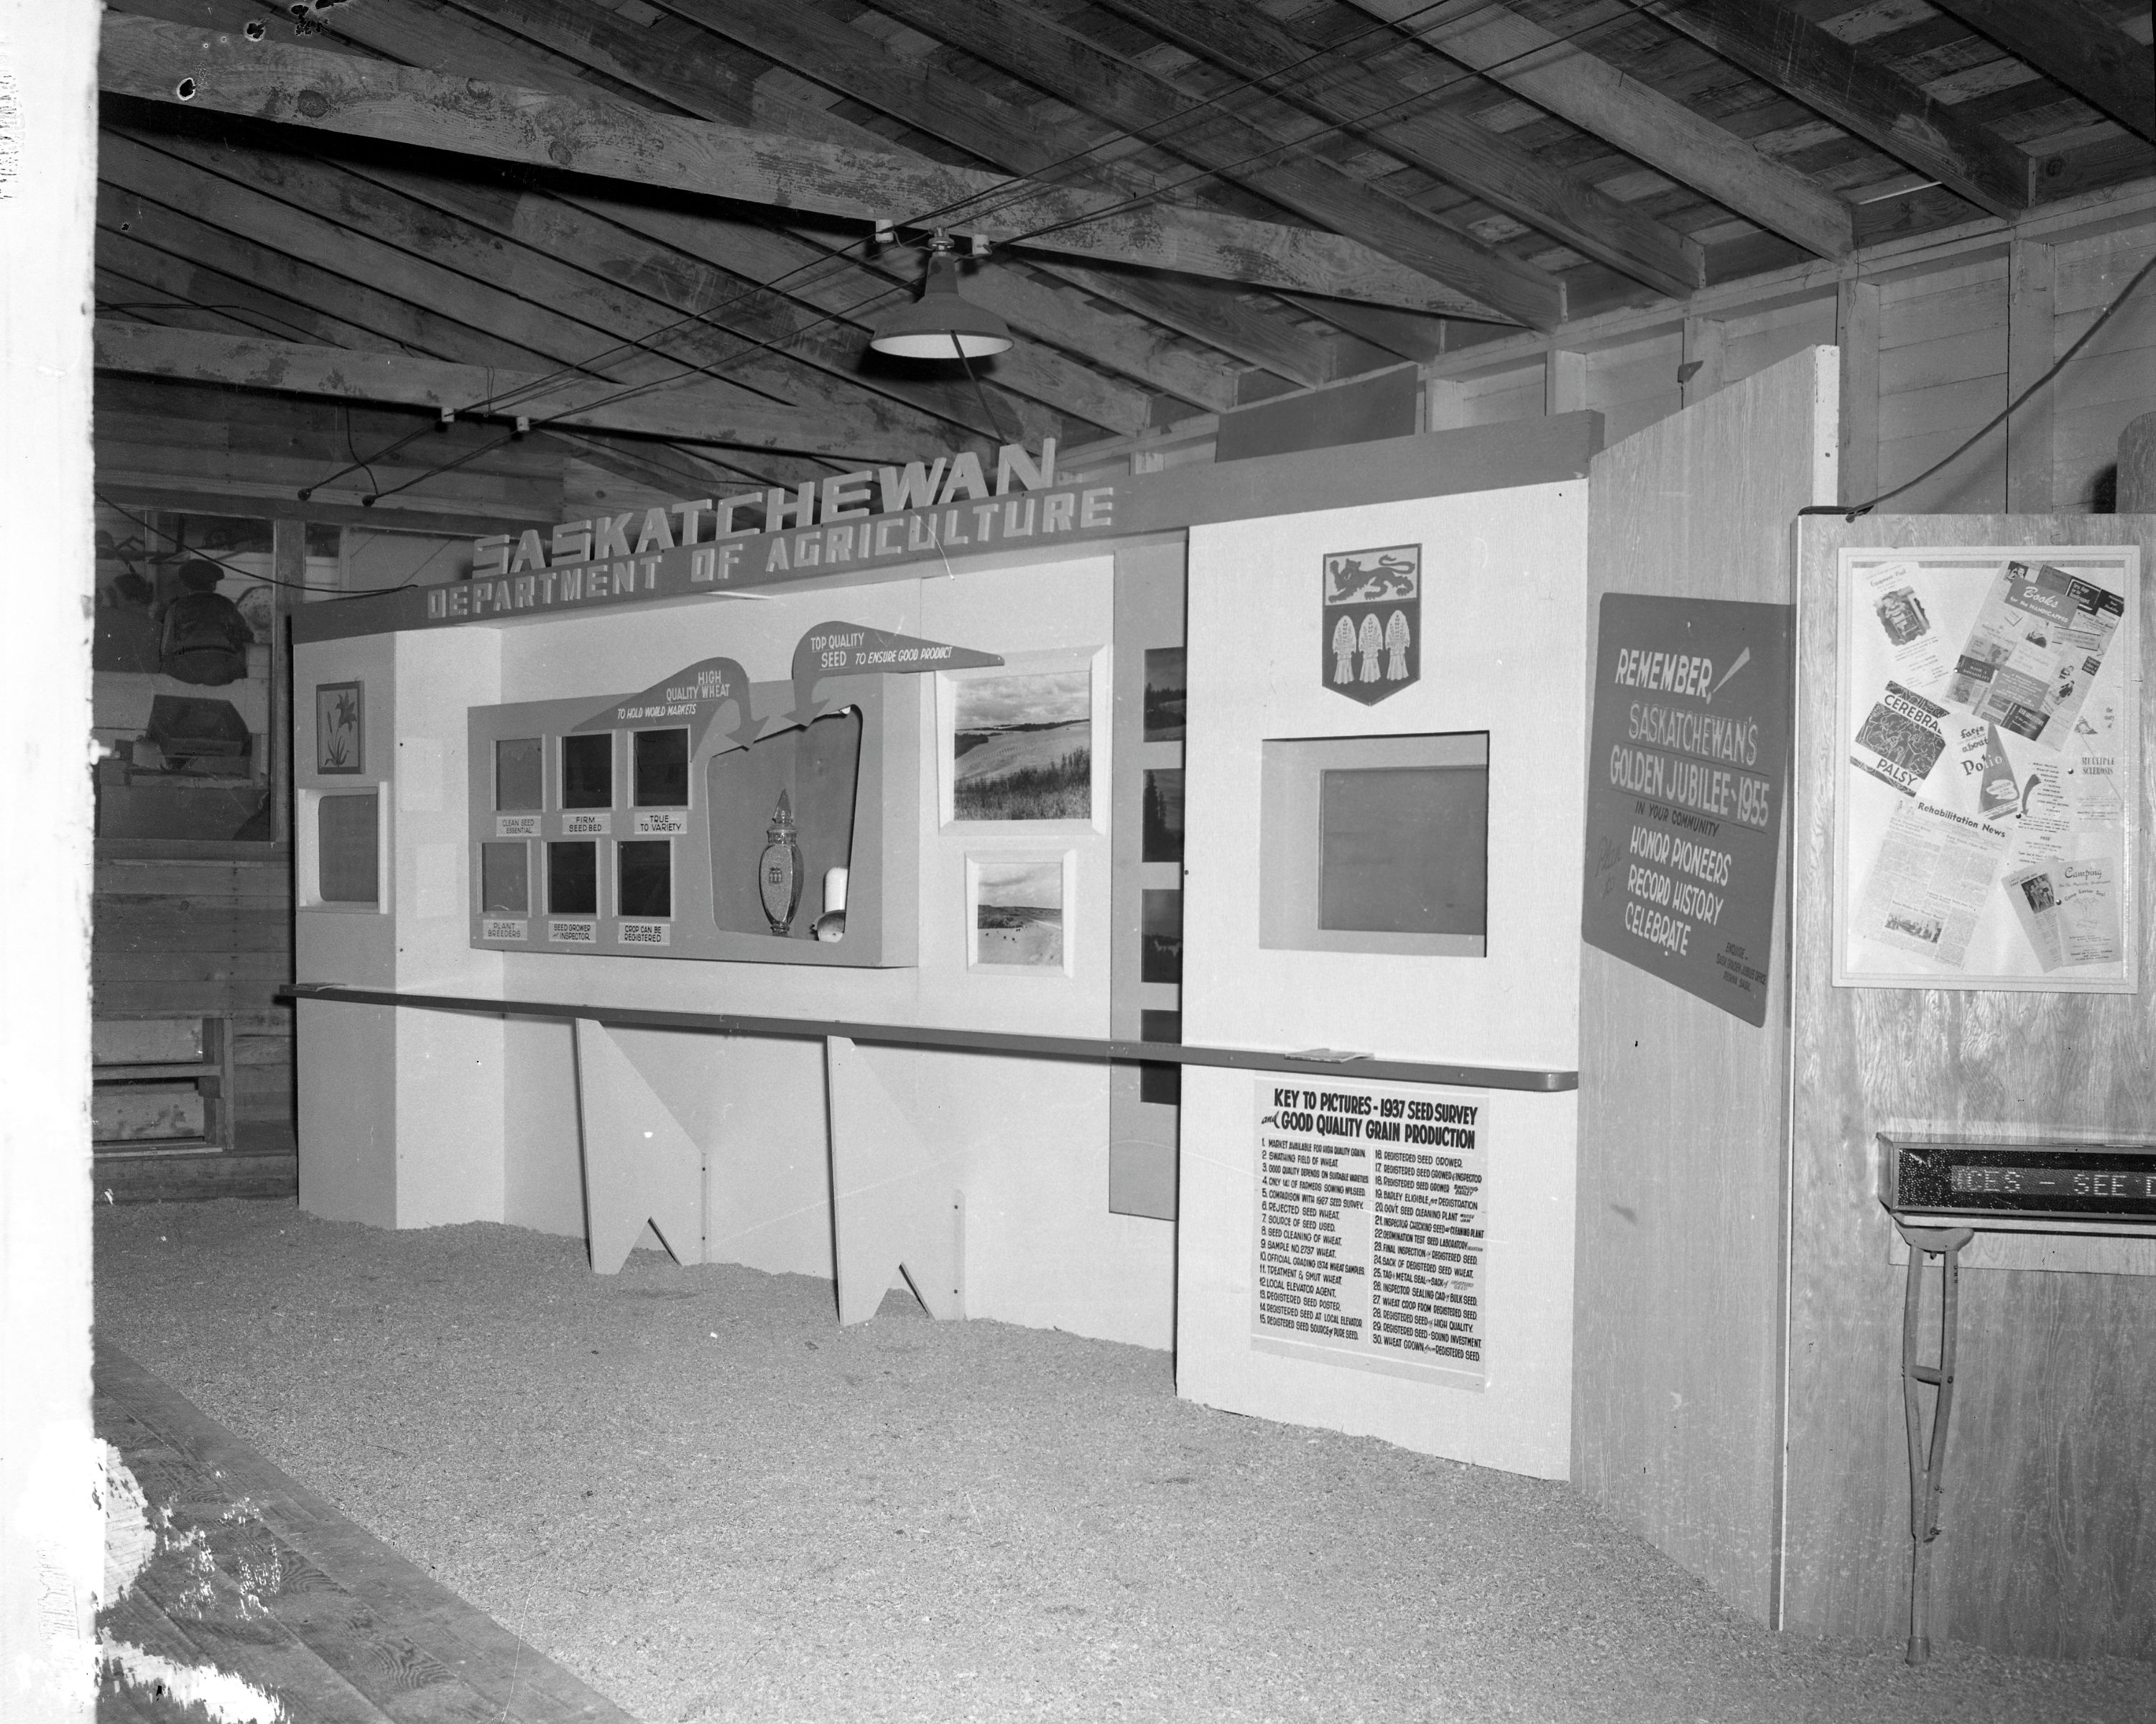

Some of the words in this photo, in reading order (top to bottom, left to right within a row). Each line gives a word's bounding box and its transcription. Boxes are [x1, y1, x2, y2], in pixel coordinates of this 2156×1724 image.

[472, 437, 1056, 579] SASKATCHEWAN
[427, 555, 662, 619] DEPARTMENT
[691, 543, 743, 583] OF
[765, 487, 1114, 573] AGRICULTURE
[2023, 586, 2058, 608] Books
[2030, 604, 2068, 623] HANDICAPPED
[811, 637, 825, 650] TOP
[829, 632, 864, 649] QUALITY
[822, 651, 846, 667] SEED
[856, 653, 866, 665] TO
[868, 651, 897, 664] ENSURE
[899, 649, 919, 661] GOOD
[920, 647, 953, 660] PRODUCT
[698, 670, 721, 684] HIGH
[666, 686, 698, 701] QUALITY
[702, 684, 730, 698] WHEAT
[618, 708, 626, 719] TO
[627, 708, 642, 718] HOLD
[645, 706, 665, 717] WORLD
[667, 704, 697, 715] MARKETS
[1629, 700, 1758, 766] SASKATCHEWAN'S
[1961, 726, 1984, 738] facts
[1962, 738, 1989, 753] about
[1610, 744, 1664, 797] GOLDEN
[1877, 758, 1917, 786] PALSY
[1961, 754, 2002, 776] Polio
[1635, 801, 1645, 815] IN
[1650, 806, 1668, 822] YOUR
[1672, 812, 1720, 837] COMMUNITY
[1918, 802, 1978, 828] Rehabilitation
[1982, 824, 2006, 838] News
[1630, 825, 1670, 864] HONOR
[1671, 838, 1731, 886] PIONEERS
[2065, 867, 2101, 880] Camping
[1628, 864, 1671, 906] RECORD
[1672, 881, 1724, 925] HISTORY
[624, 933, 662, 942] REGISTERED
[625, 925, 639, 934] CROP
[640, 925, 652, 934] CAN
[652, 925, 662, 934] BE
[1625, 902, 1691, 956] CELEBRATE
[1274, 1088, 1300, 1108] KEY
[1303, 1091, 1317, 1110] TO
[1320, 1093, 1371, 1116] PICTURES
[1380, 1098, 1405, 1118] 1937
[1407, 1100, 1433, 1121] SEED
[1434, 1103, 1478, 1126] SURVEY
[1262, 1111, 1280, 1129] and
[1282, 1111, 1313, 1132] GOOD
[1317, 1114, 1363, 1137] QUALITY
[1366, 1119, 1400, 1141] GRAIN
[1405, 1123, 1475, 1149] PRODUCTION
[1384, 1151, 1416, 1163] REGISTERED
[1417, 1154, 1433, 1165] SEED
[2073, 1174, 2127, 1195] SEE
[1384, 1190, 1402, 1201] BARLEY
[1405, 1194, 1428, 1205] ELIGIBLE
[1438, 1197, 1478, 1210] REGISTRATION
[1268, 1215, 1291, 1225] SOURCE
[1293, 1218, 1300, 1227] OF
[1303, 1220, 1316, 1229] SEED
[1268, 1228, 1282, 1238] SEED
[1283, 1230, 1312, 1242] CLEANING
[1313, 1234, 1321, 1243] OF
[1267, 1266, 1297, 1278] TREATMENT
[1305, 1271, 1320, 1282] SMUT
[1382, 1256, 1396, 1267] SACK
[1398, 1259, 1405, 1268] OF
[1406, 1261, 1436, 1274] REGISTERED
[1438, 1265, 1452, 1276] SEED
[1267, 1279, 1285, 1289] LOCAL
[1287, 1282, 1314, 1294] ELEVATOR
[1267, 1292, 1300, 1304] REGISTERED
[1303, 1297, 1317, 1307] SEED
[1383, 1297, 1399, 1307] WHEAT
[1402, 1300, 1416, 1310] CROP
[1417, 1303, 1431, 1313] FROM
[1433, 1304, 1461, 1318] REGISTERED
[1383, 1310, 1413, 1323] REGISTERED
[1415, 1315, 1428, 1325] SEED
[1434, 1319, 1448, 1329] HIGH
[1383, 1323, 1413, 1336] REGISTERED
[1415, 1328, 1428, 1338] SEED
[1431, 1330, 1449, 1343] SOUND
